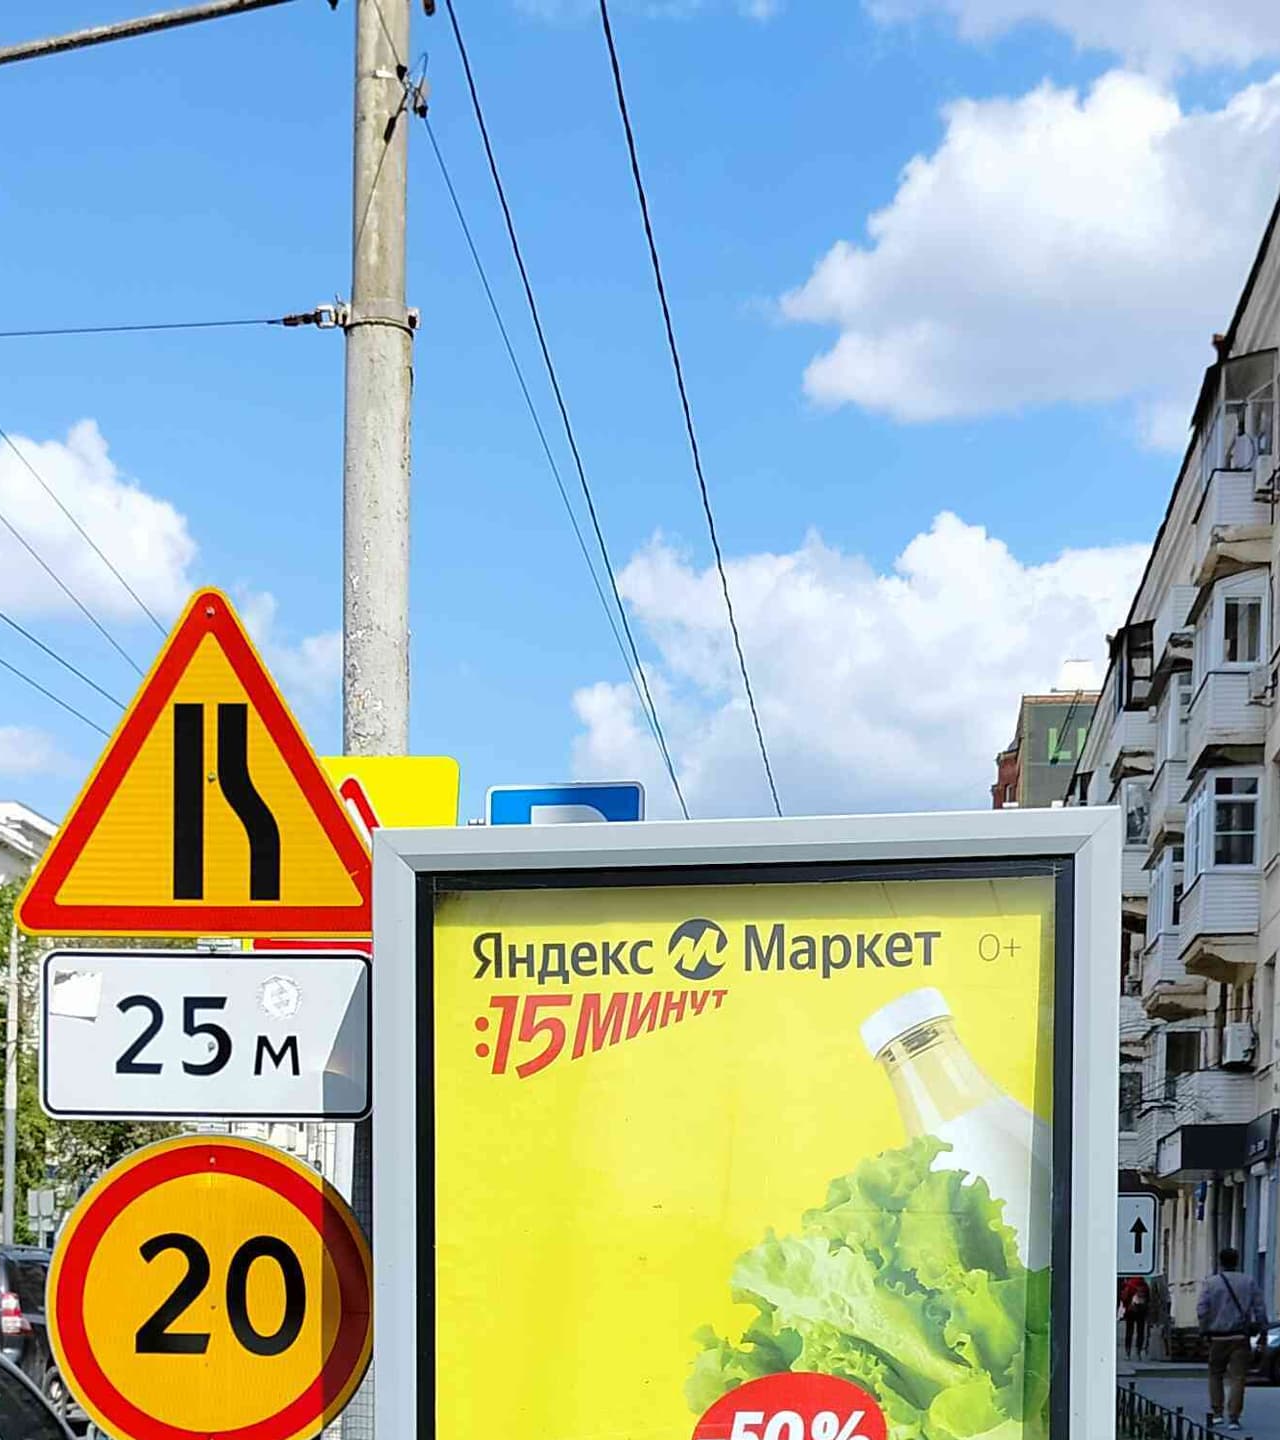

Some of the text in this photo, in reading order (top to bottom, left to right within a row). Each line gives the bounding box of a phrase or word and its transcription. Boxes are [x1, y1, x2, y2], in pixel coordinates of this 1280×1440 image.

[473, 923, 941, 985] Яндекс Маркет
[978, 933, 1022, 961] 0+
[116, 995, 232, 1075] 25
[134, 1232, 306, 1356] 20
